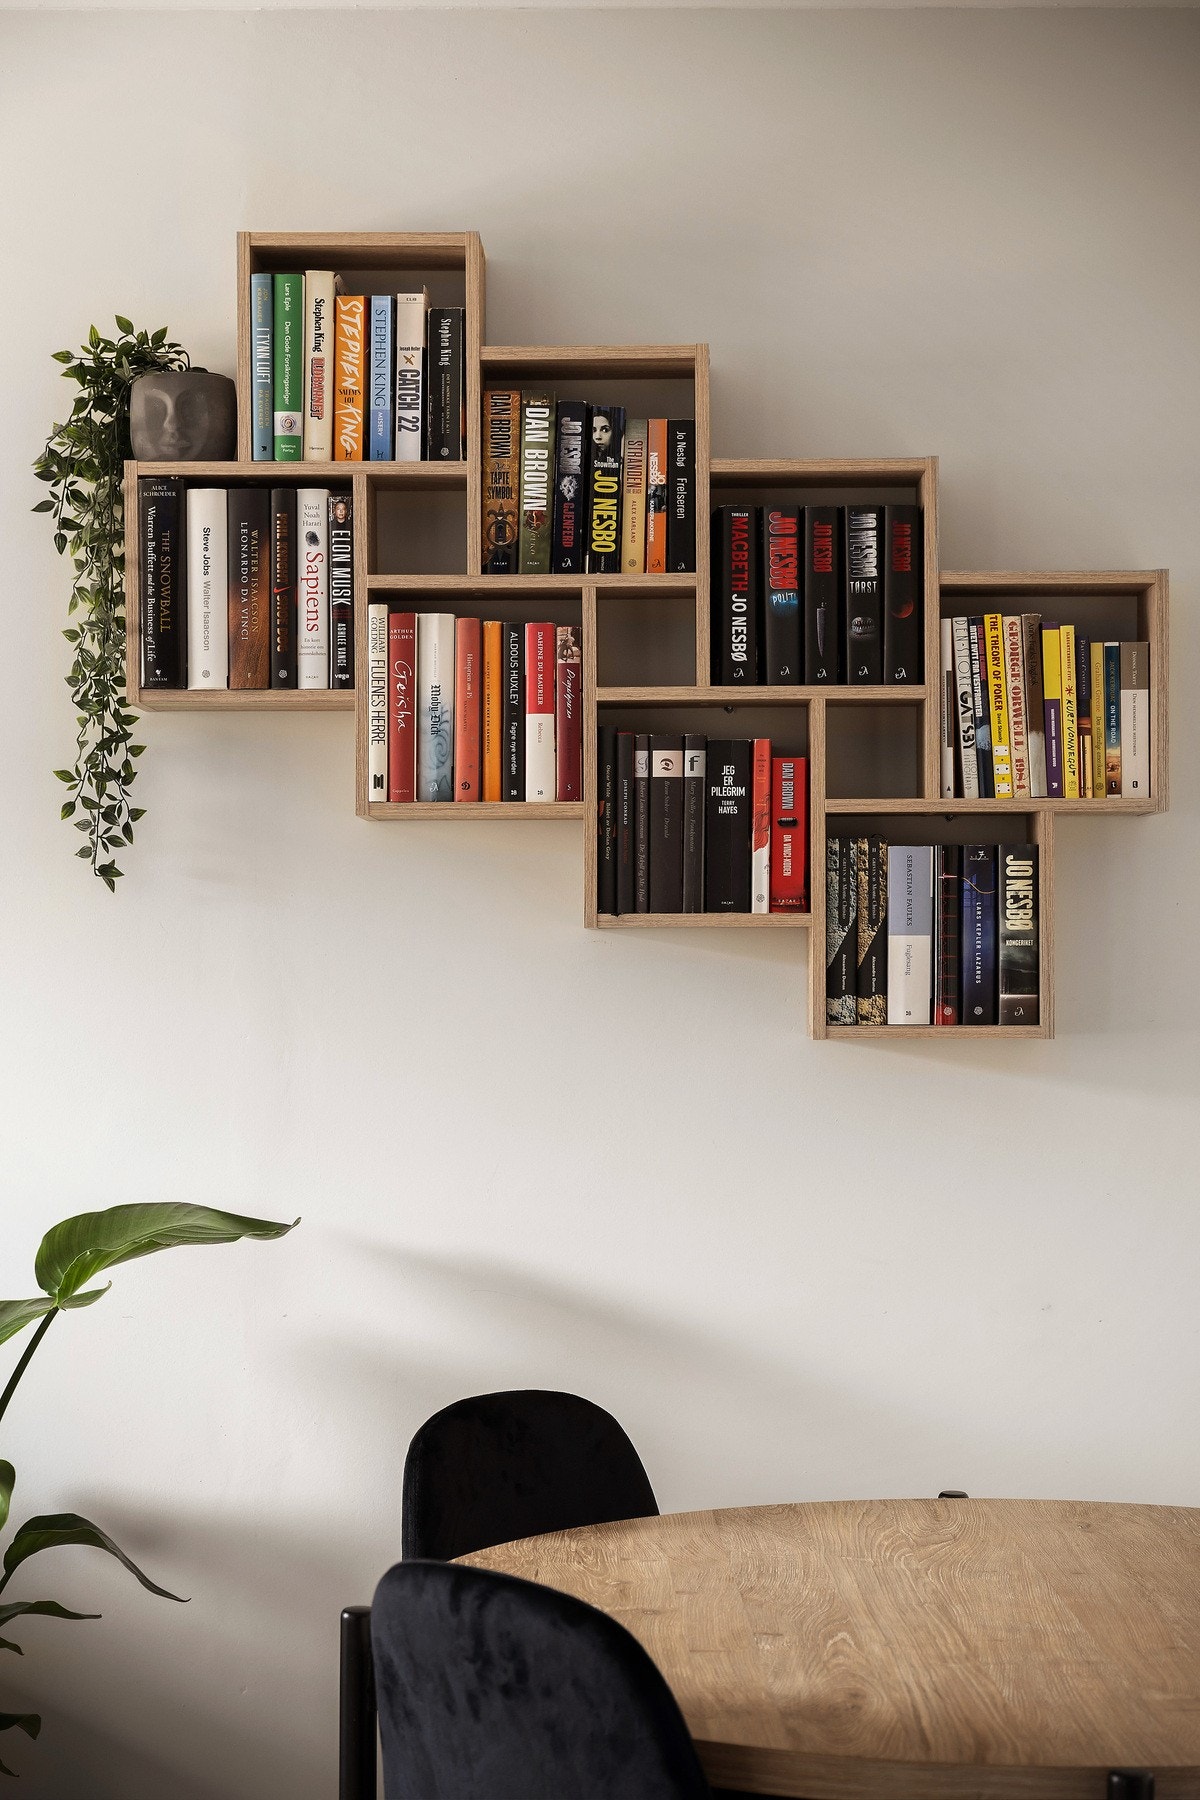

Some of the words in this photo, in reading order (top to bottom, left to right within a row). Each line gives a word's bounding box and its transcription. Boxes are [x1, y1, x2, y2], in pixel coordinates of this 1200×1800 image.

[312, 298, 325, 332] Stephen
[256, 334, 270, 359] TYNN
[312, 333, 325, 352] King
[338, 296, 364, 391] STEPHEN
[375, 310, 387, 368] STEPHEN
[438, 318, 452, 347] Stephen
[256, 362, 270, 384] LUFT
[438, 350, 452, 366] King
[310, 357, 325, 420] ILDBARNET
[374, 373, 386, 407] KING
[398, 369, 420, 410] CATCH
[490, 394, 512, 416] DAN
[335, 403, 362, 452] KING
[398, 416, 420, 432] 22
[490, 419, 512, 458] BROWN
[526, 407, 550, 442] DAN
[561, 417, 582, 434] JO
[676, 431, 685, 440] Jo
[560, 435, 582, 475] NESBØ
[594, 460, 618, 468] Snowman
[626, 440, 644, 488] STRANDEN
[650, 452, 658, 485] NESBØ
[676, 442, 686, 467] Nesbø
[487, 486, 514, 500] SYMBOL
[490, 472, 510, 484] TAPTE
[523, 448, 550, 511] BROWN
[594, 470, 618, 493] JO
[658, 472, 666, 484] JO
[676, 478, 688, 519] Frelseren
[147, 506, 156, 538] Warren
[276, 514, 288, 538] PHIL
[562, 502, 575, 548] GJENFERD
[592, 498, 617, 553] NESBO
[769, 512, 798, 534] JO
[814, 521, 832, 536] JO
[850, 512, 877, 528] JO
[892, 520, 912, 536] JO
[161, 531, 170, 552] THE
[202, 528, 210, 552] Steve
[240, 522, 248, 584] LEONARDO
[250, 530, 259, 572] WALTER
[332, 530, 350, 561] ELON
[732, 517, 749, 592] MACBETH
[813, 538, 832, 573] NESBØ
[849, 530, 878, 578] NESBØ
[892, 537, 912, 572] NESBØ
[147, 541, 156, 572] Buffett
[202, 554, 210, 576] Jobs
[276, 542, 288, 584] KNIGHT
[769, 537, 798, 590] NESBØ
[160, 556, 171, 632] SNOWBALL
[203, 580, 211, 610] Walter
[240, 588, 248, 603] DA
[300, 552, 324, 632] Sapiens
[332, 568, 350, 606] MUSK
[850, 580, 877, 594] TØRST
[147, 598, 156, 634] Business
[250, 578, 259, 632] ISAACSON
[276, 594, 288, 625] SHOE
[732, 594, 748, 612] JO
[203, 611, 211, 652] Isaacson
[338, 622, 346, 646] ASHLEE
[370, 617, 378, 654] GOLDING
[378, 617, 386, 653] WILLIAM
[730, 616, 748, 662] NESBØ
[954, 620, 968, 642] DEN
[990, 615, 998, 632] THE
[145, 636, 156, 644] of
[147, 645, 156, 662] Life
[276, 627, 288, 652] DOG
[510, 632, 518, 668] ALDOUS
[990, 634, 1000, 668] THEORY
[1008, 621, 1022, 683] GEORGE
[338, 646, 346, 666] VANCE
[464, 654, 474, 682] Historien
[958, 648, 972, 688] STORE
[370, 660, 386, 707] FLUENES
[467, 682, 471, 690] om
[510, 670, 518, 706] HUXLEY
[992, 670, 1002, 681] OF
[392, 661, 412, 734] Geisha
[428, 685, 442, 736] Moby-Dick
[994, 684, 1004, 711] POKER
[1066, 699, 1074, 724] KURT
[1110, 706, 1116, 714] ON
[370, 711, 386, 746] HERRE
[509, 722, 518, 740] Fagre
[960, 690, 976, 750] GATSBY
[1010, 686, 1024, 752] ORWELL
[1066, 726, 1076, 776] VONNEGUT
[721, 765, 736, 776] JEG
[723, 776, 734, 786] ER
[782, 763, 794, 778] DAN
[1015, 758, 1026, 790] 1984
[688, 781, 696, 796] Mary
[710, 786, 746, 796] PILEGRIM
[782, 780, 794, 810] BROWN
[718, 806, 738, 814] HAYES
[782, 842, 792, 876] VINCI-KODEN
[1006, 855, 1034, 877] JO
[1005, 880, 1034, 930] NESBØ
[904, 944, 912, 976] Fuglesang
